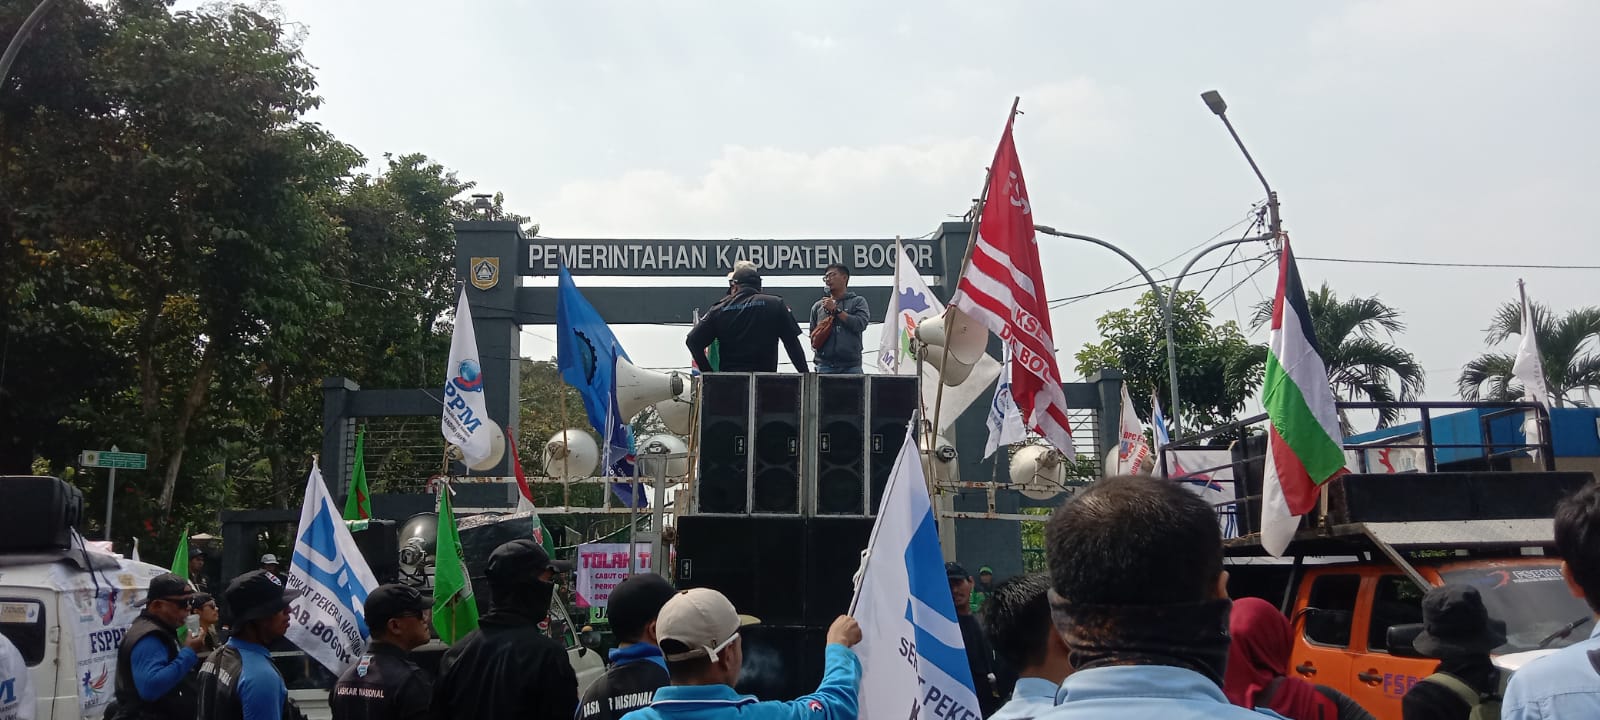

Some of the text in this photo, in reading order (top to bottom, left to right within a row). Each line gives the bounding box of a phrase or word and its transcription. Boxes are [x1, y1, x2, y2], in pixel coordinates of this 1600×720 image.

[529, 244, 707, 269] PEMERINTAHAN
[716, 244, 843, 269] KABUPATEN
[581, 552, 630, 569] TOLAK
[1384, 673, 1423, 695] FSP
